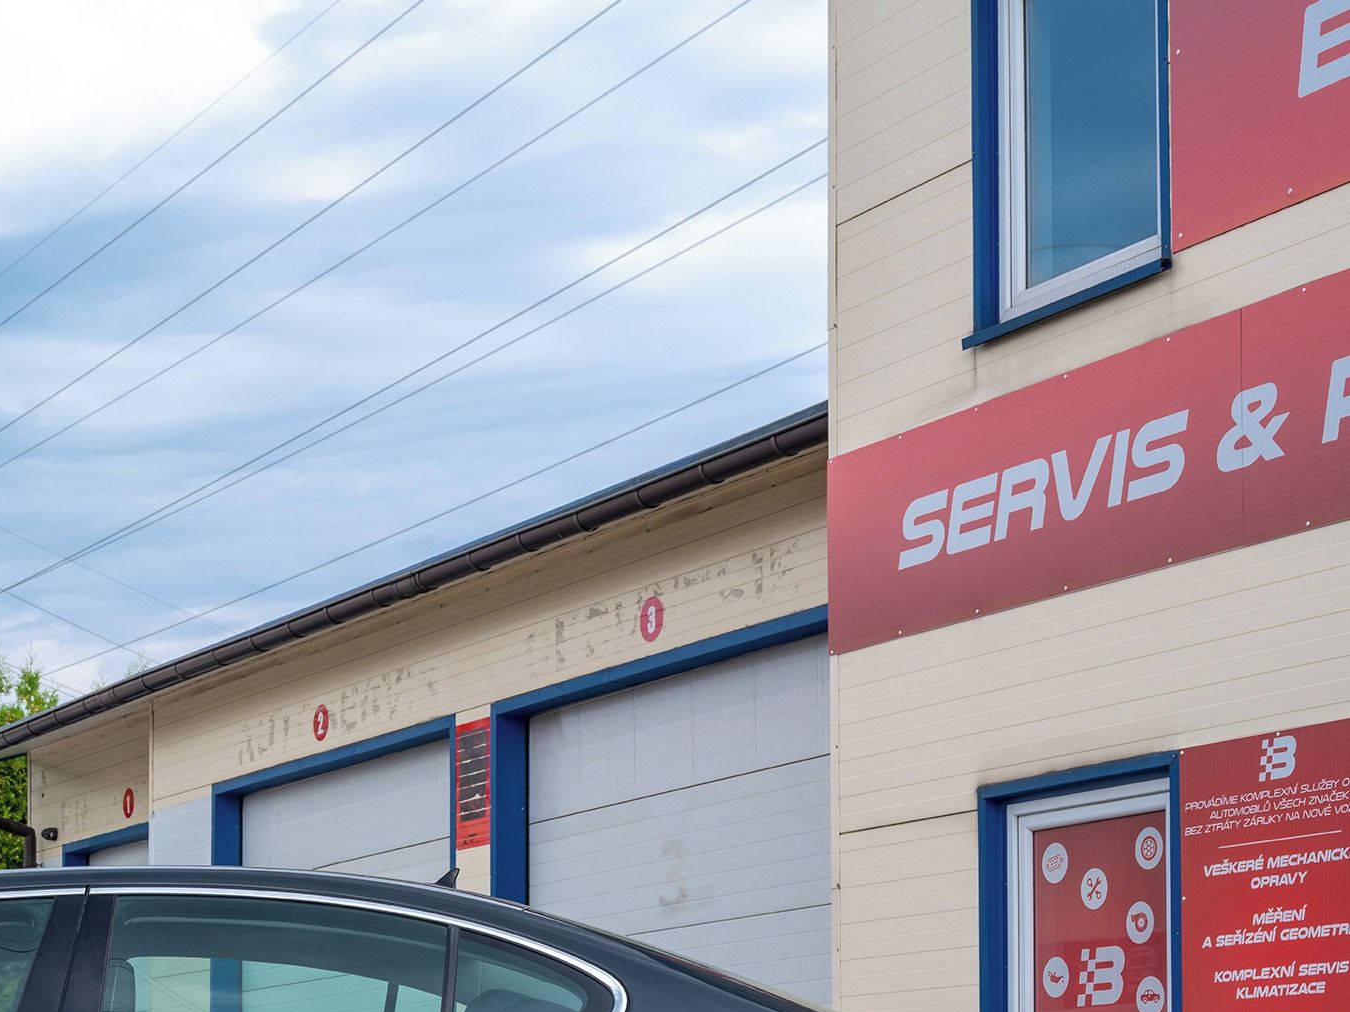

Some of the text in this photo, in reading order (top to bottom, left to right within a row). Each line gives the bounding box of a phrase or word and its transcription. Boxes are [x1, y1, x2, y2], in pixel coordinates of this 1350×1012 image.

[898, 409, 1189, 570] SERVIS
[1216, 382, 1290, 473] &
[647, 605, 656, 634] 3
[317, 711, 324, 735] 2
[1184, 795, 1239, 811] PROVÁDÍME
[1240, 783, 1299, 803] KOMPLEXNÍ
[1300, 778, 1340, 794] SLUŽBY
[1209, 789, 1349, 820] AUTOMOBILŮ VŠECH ZNAČEK
[1184, 803, 1350, 836] BEZ ZTRÁTY ZÁRUKY NA NOVÉ VO
[1203, 847, 1350, 877] VEŠKERÉ MECHANICK
[1250, 870, 1308, 889] OPRAVY
[1252, 904, 1307, 925] MĚŘENÍ
[1201, 936, 1212, 949] A
[1214, 960, 1350, 983] KOMPLEXNÍ SERVIS
[1236, 981, 1326, 1000] KLIMATIZACE
